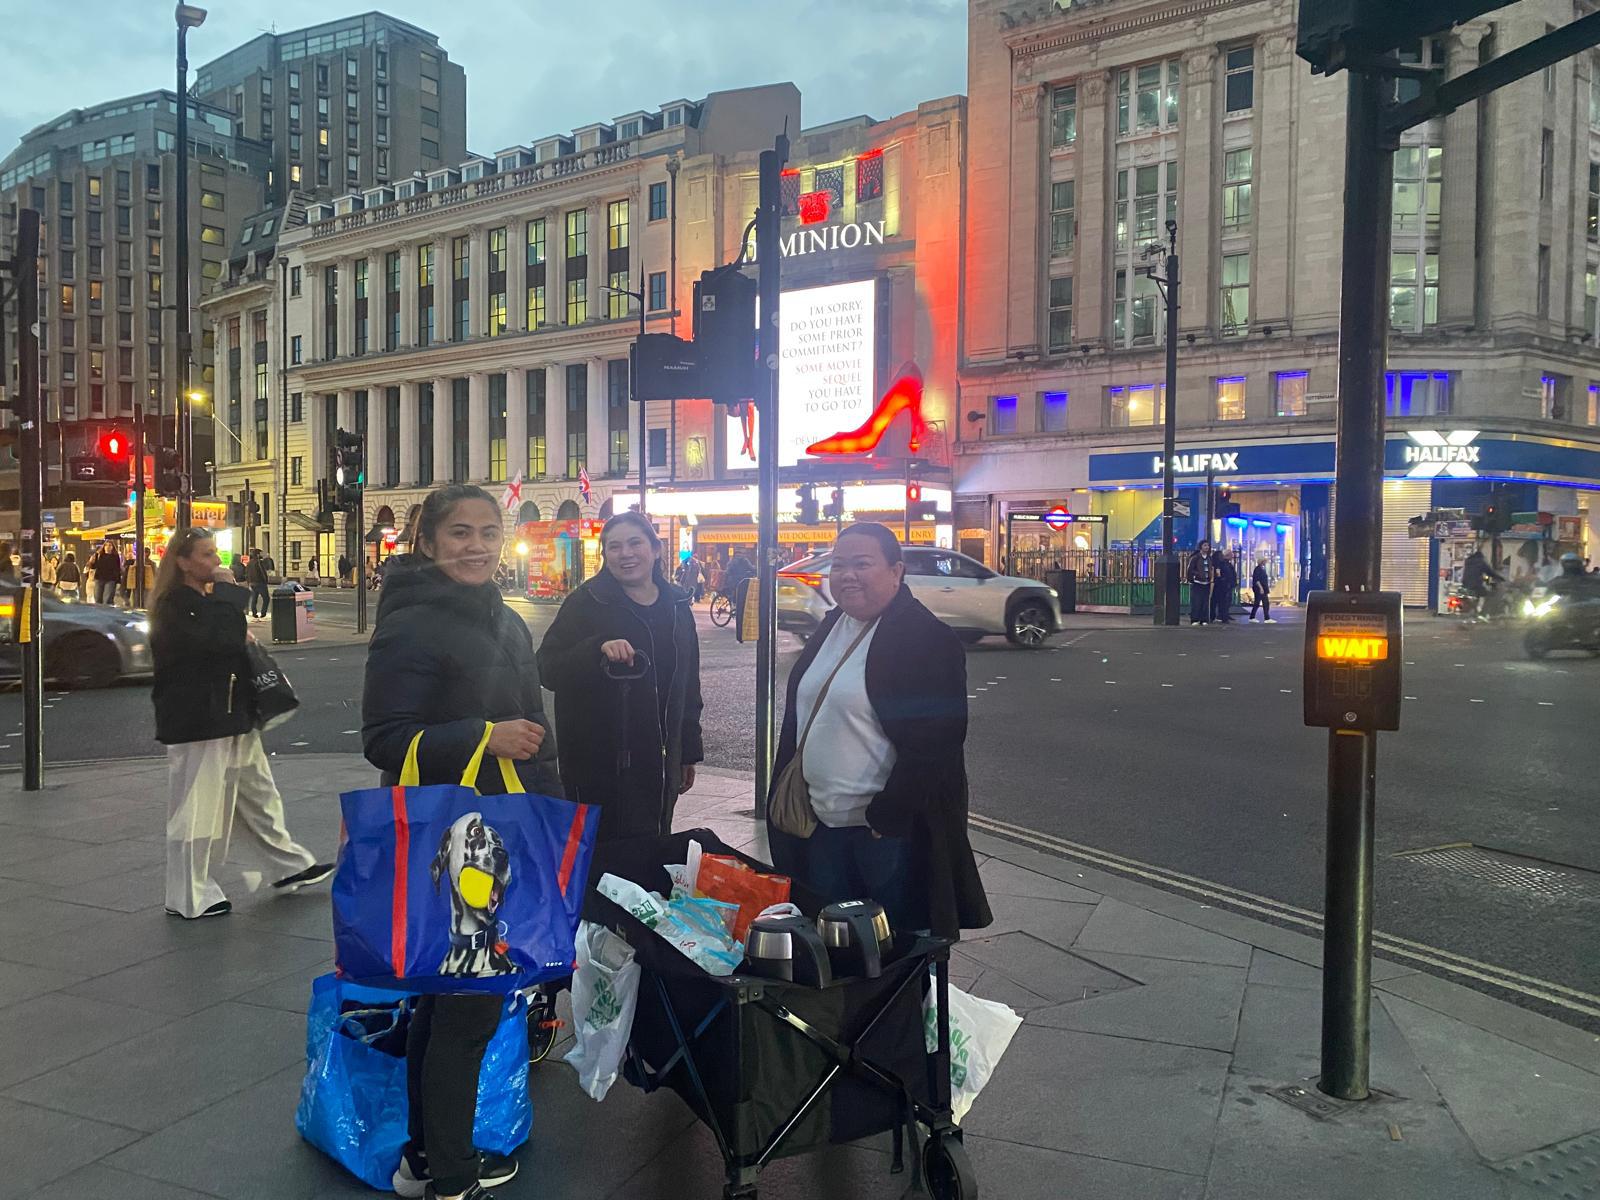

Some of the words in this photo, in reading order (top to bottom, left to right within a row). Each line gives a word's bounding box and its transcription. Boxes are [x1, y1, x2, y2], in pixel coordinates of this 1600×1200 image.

[790, 320, 807, 332] DO
[810, 316, 832, 329] YOU
[835, 313, 862, 326] HAVE
[798, 332, 826, 344] SOME
[830, 327, 864, 340] PRIOR
[795, 361, 823, 374] SOME
[827, 358, 862, 371] MOVIE
[823, 372, 862, 386] SEQUEL
[809, 387, 831, 399] YOU
[834, 385, 862, 397] HAVE
[805, 402, 819, 413] TO
[821, 400, 839, 412] GO
[1405, 446, 1481, 463] HALIFAX
[1324, 638, 1383, 659] WAIT
